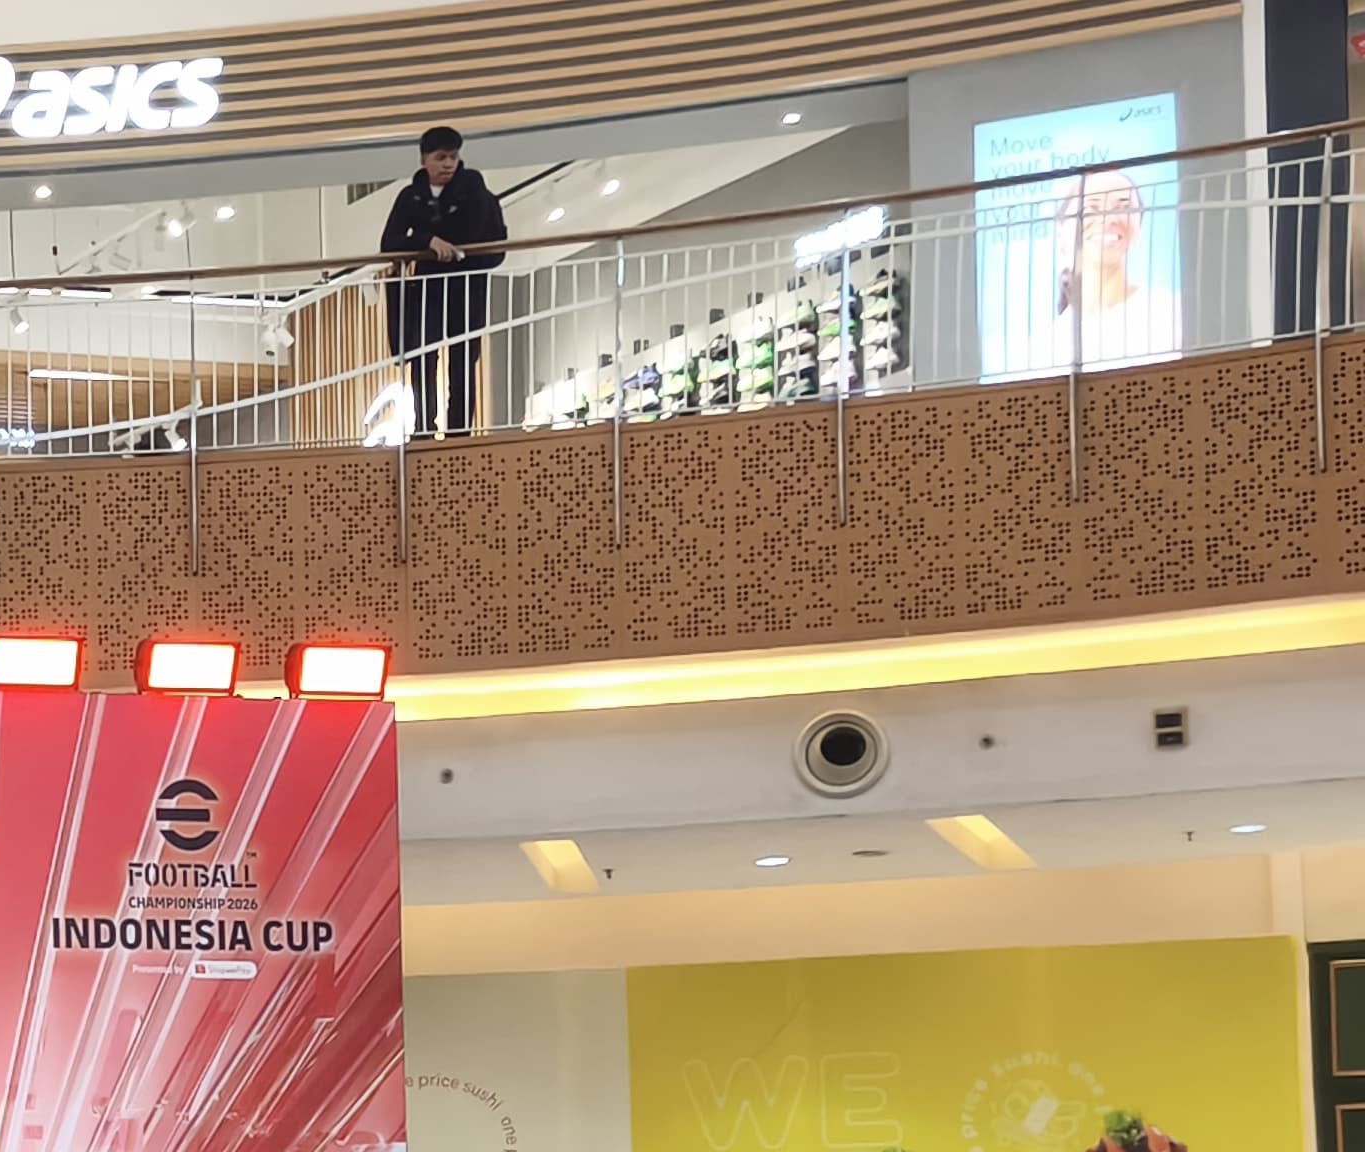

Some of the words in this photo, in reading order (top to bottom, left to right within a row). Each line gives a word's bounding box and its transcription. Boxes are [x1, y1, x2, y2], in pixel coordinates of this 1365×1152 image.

[11, 57, 225, 138] asics
[990, 135, 1053, 157] Move
[128, 862, 258, 888] FOOTBALL
[128, 896, 225, 910] CHAMPIONSHIP
[228, 898, 258, 911] 2026
[52, 917, 253, 951] INDONESIA
[263, 920, 333, 952] CUP
[418, 1072, 460, 1090] price
[462, 1081, 504, 1111] sushi
[500, 1116, 517, 1146] one
